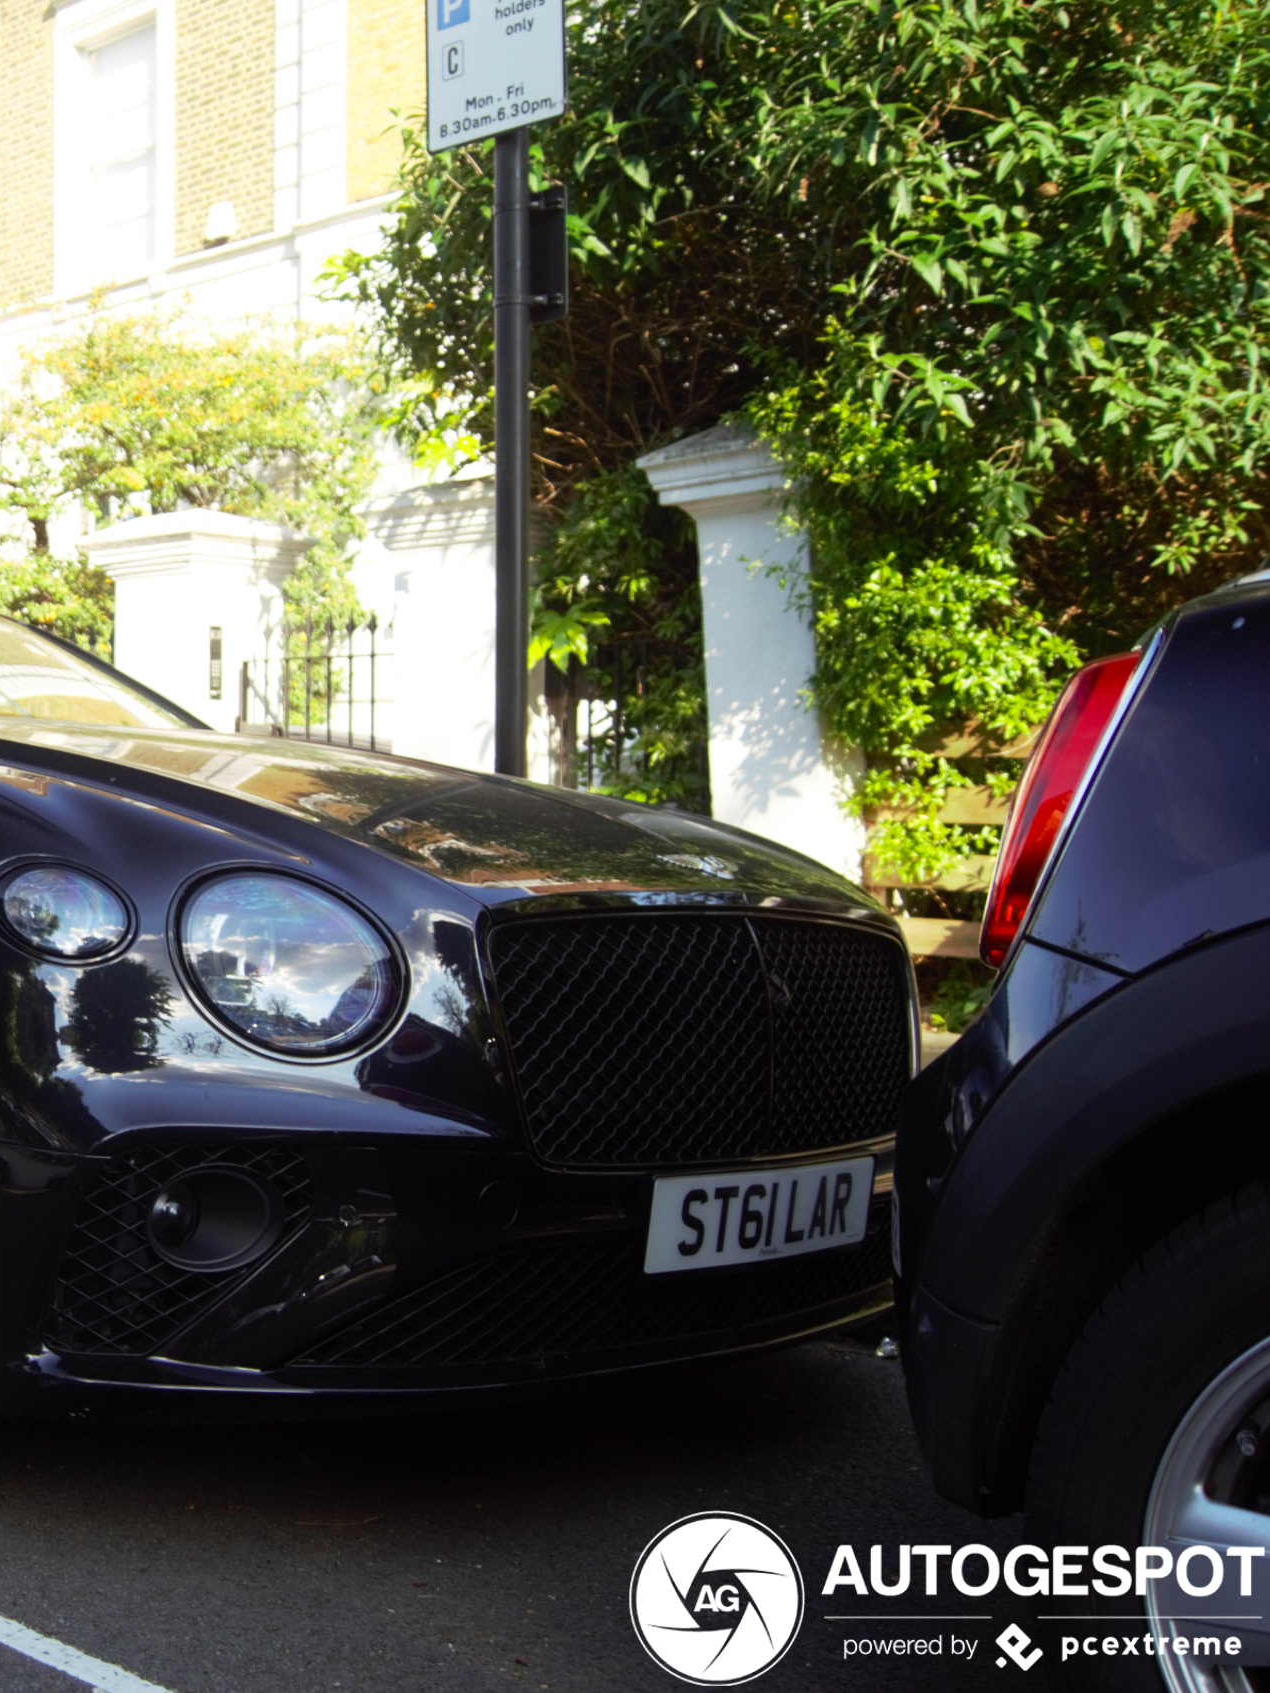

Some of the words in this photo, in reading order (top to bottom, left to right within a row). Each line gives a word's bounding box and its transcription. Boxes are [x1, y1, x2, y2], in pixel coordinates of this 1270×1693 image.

[495, 0, 546, 20] holders
[506, 18, 535, 36] only
[447, 46, 459, 76] C
[465, 94, 494, 112] Mon
[506, 82, 524, 100] Fri
